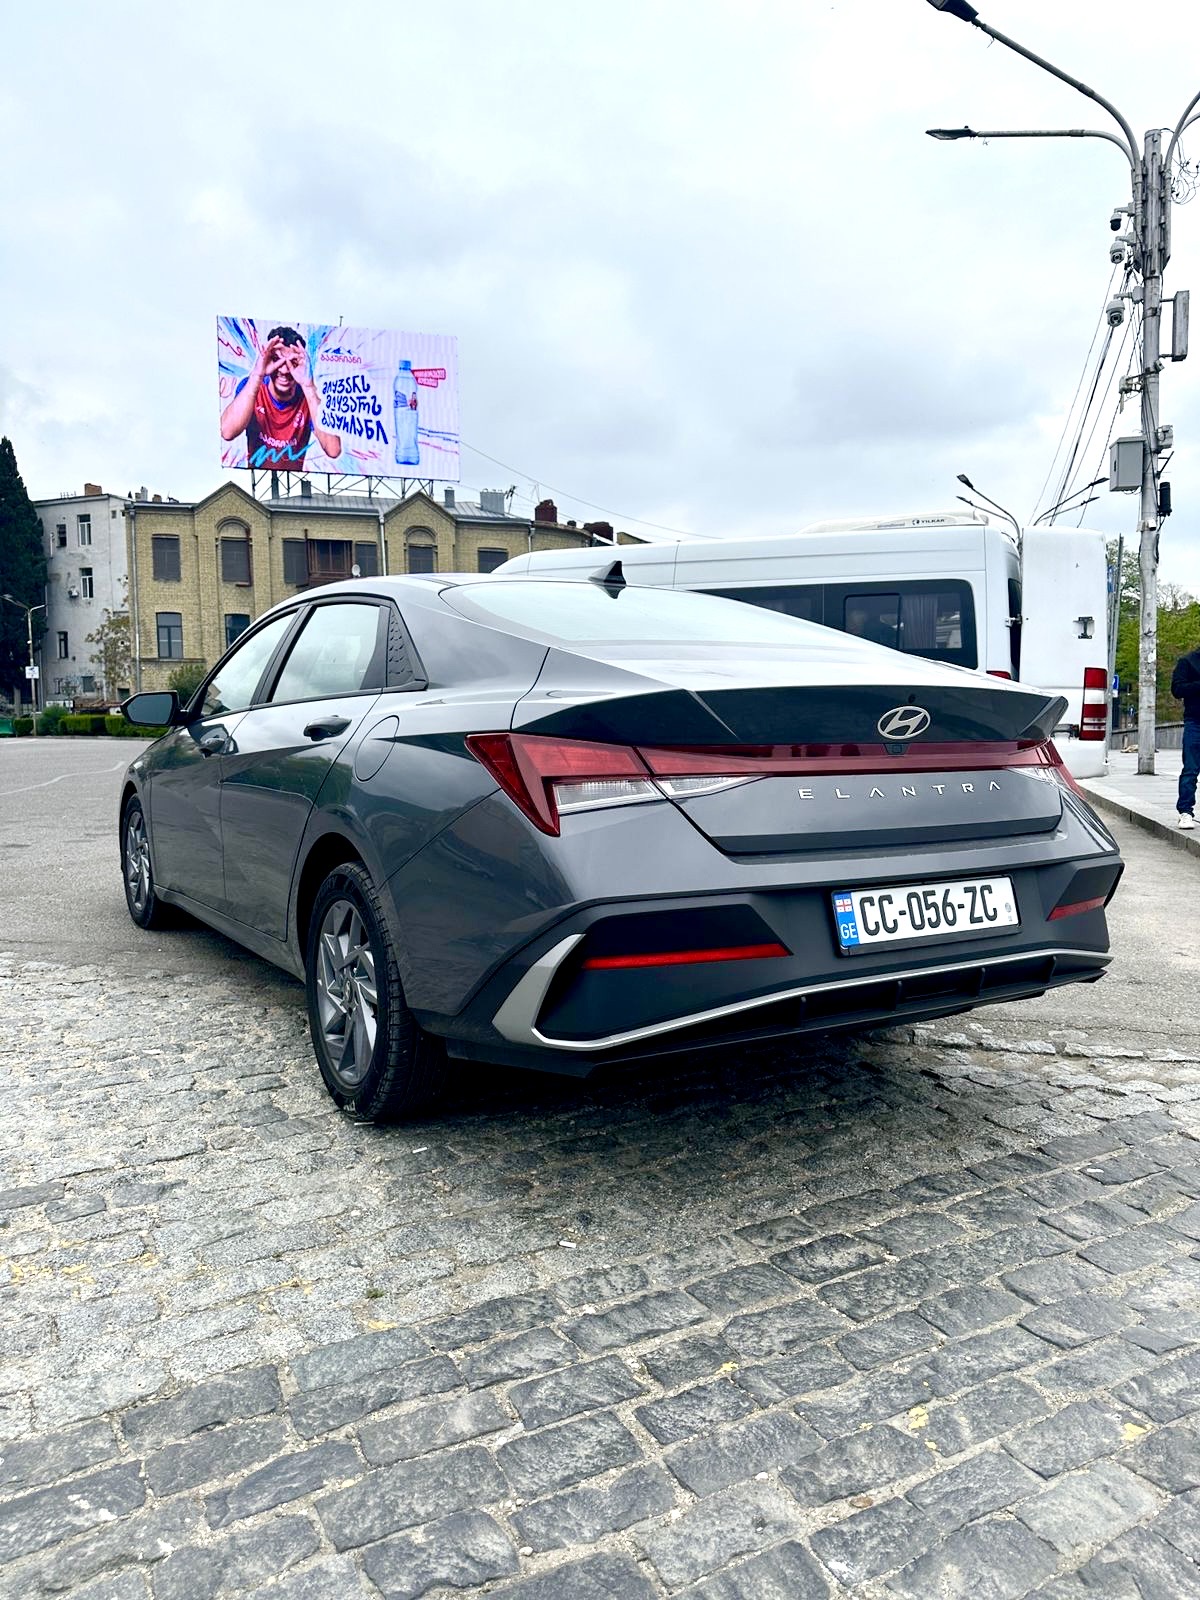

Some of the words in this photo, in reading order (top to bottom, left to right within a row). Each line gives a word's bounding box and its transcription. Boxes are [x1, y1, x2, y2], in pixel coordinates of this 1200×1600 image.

[798, 780, 1001, 799] ELANTRA
[859, 884, 998, 936] CC-056-ZC
[839, 922, 858, 939] GE
